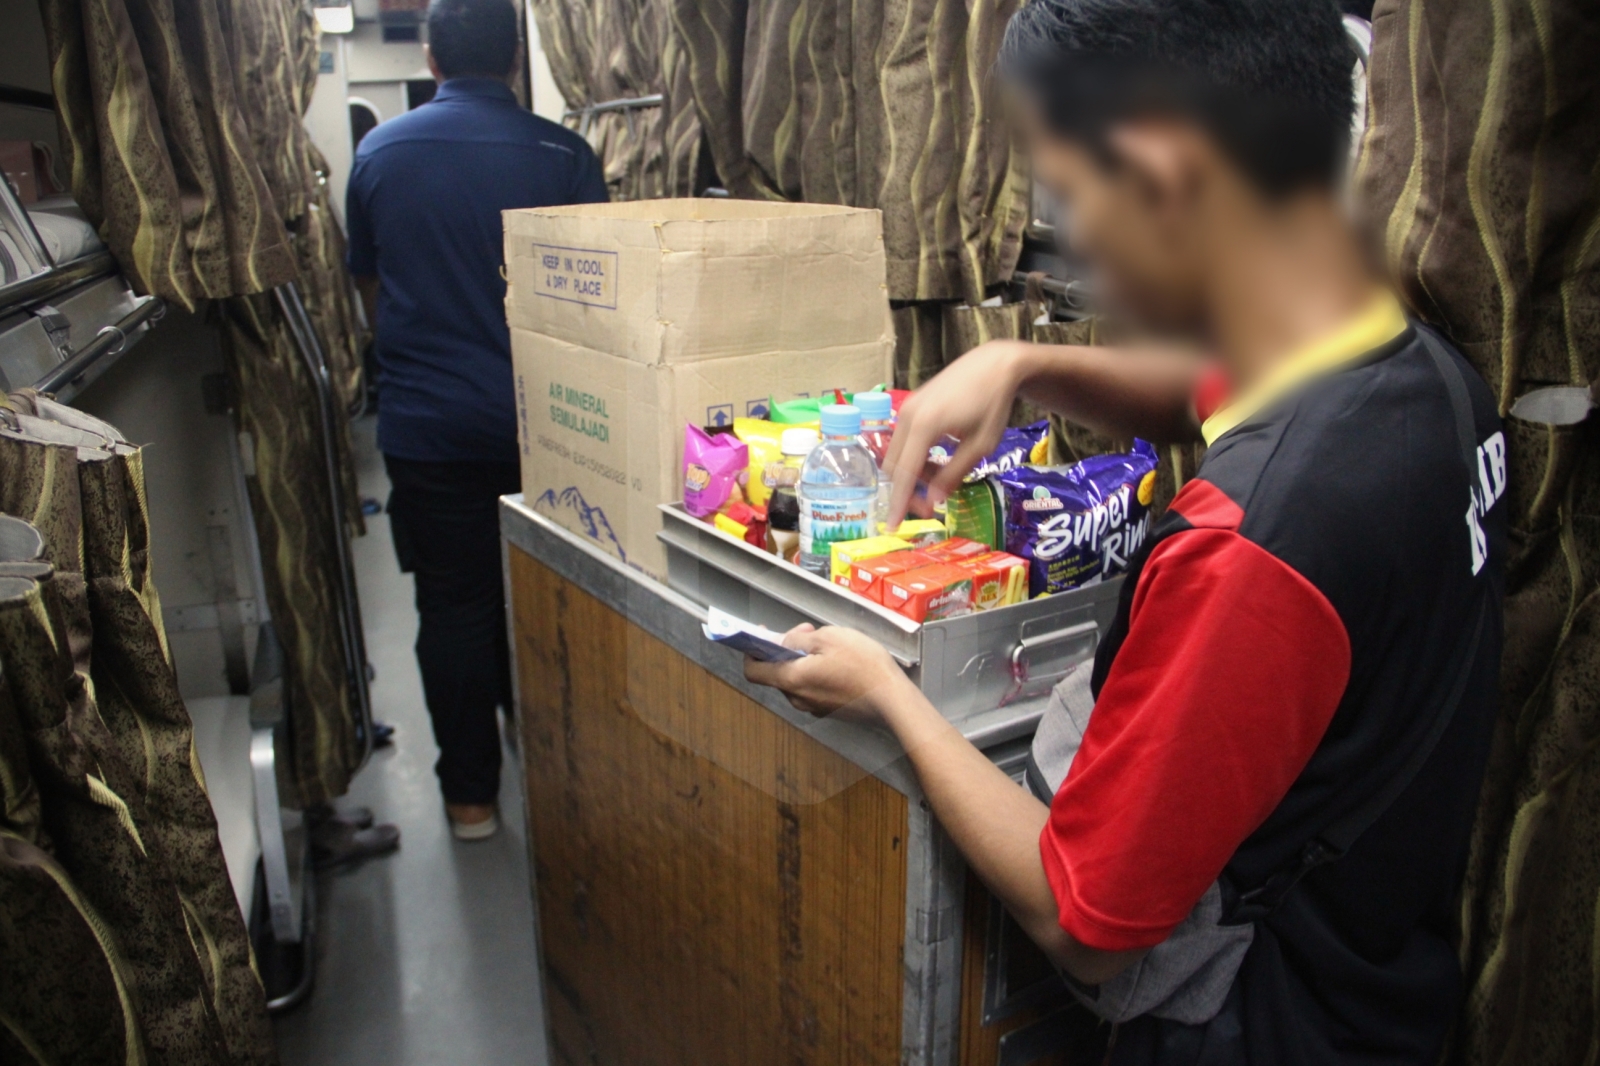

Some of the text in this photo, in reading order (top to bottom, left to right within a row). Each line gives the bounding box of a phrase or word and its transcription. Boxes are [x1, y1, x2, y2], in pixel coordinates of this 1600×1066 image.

[542, 254, 604, 276] KEEP IN COOL
[553, 276, 568, 291] DRY
[574, 279, 601, 296] PLACE
[565, 387, 610, 418] MINERAL
[549, 405, 610, 443] SEMULAJADI
[1023, 498, 1063, 510] ORIENTAL
[812, 510, 867, 522] PineFresh
[1035, 484, 1132, 560] Super
[981, 592, 998, 603] REX
